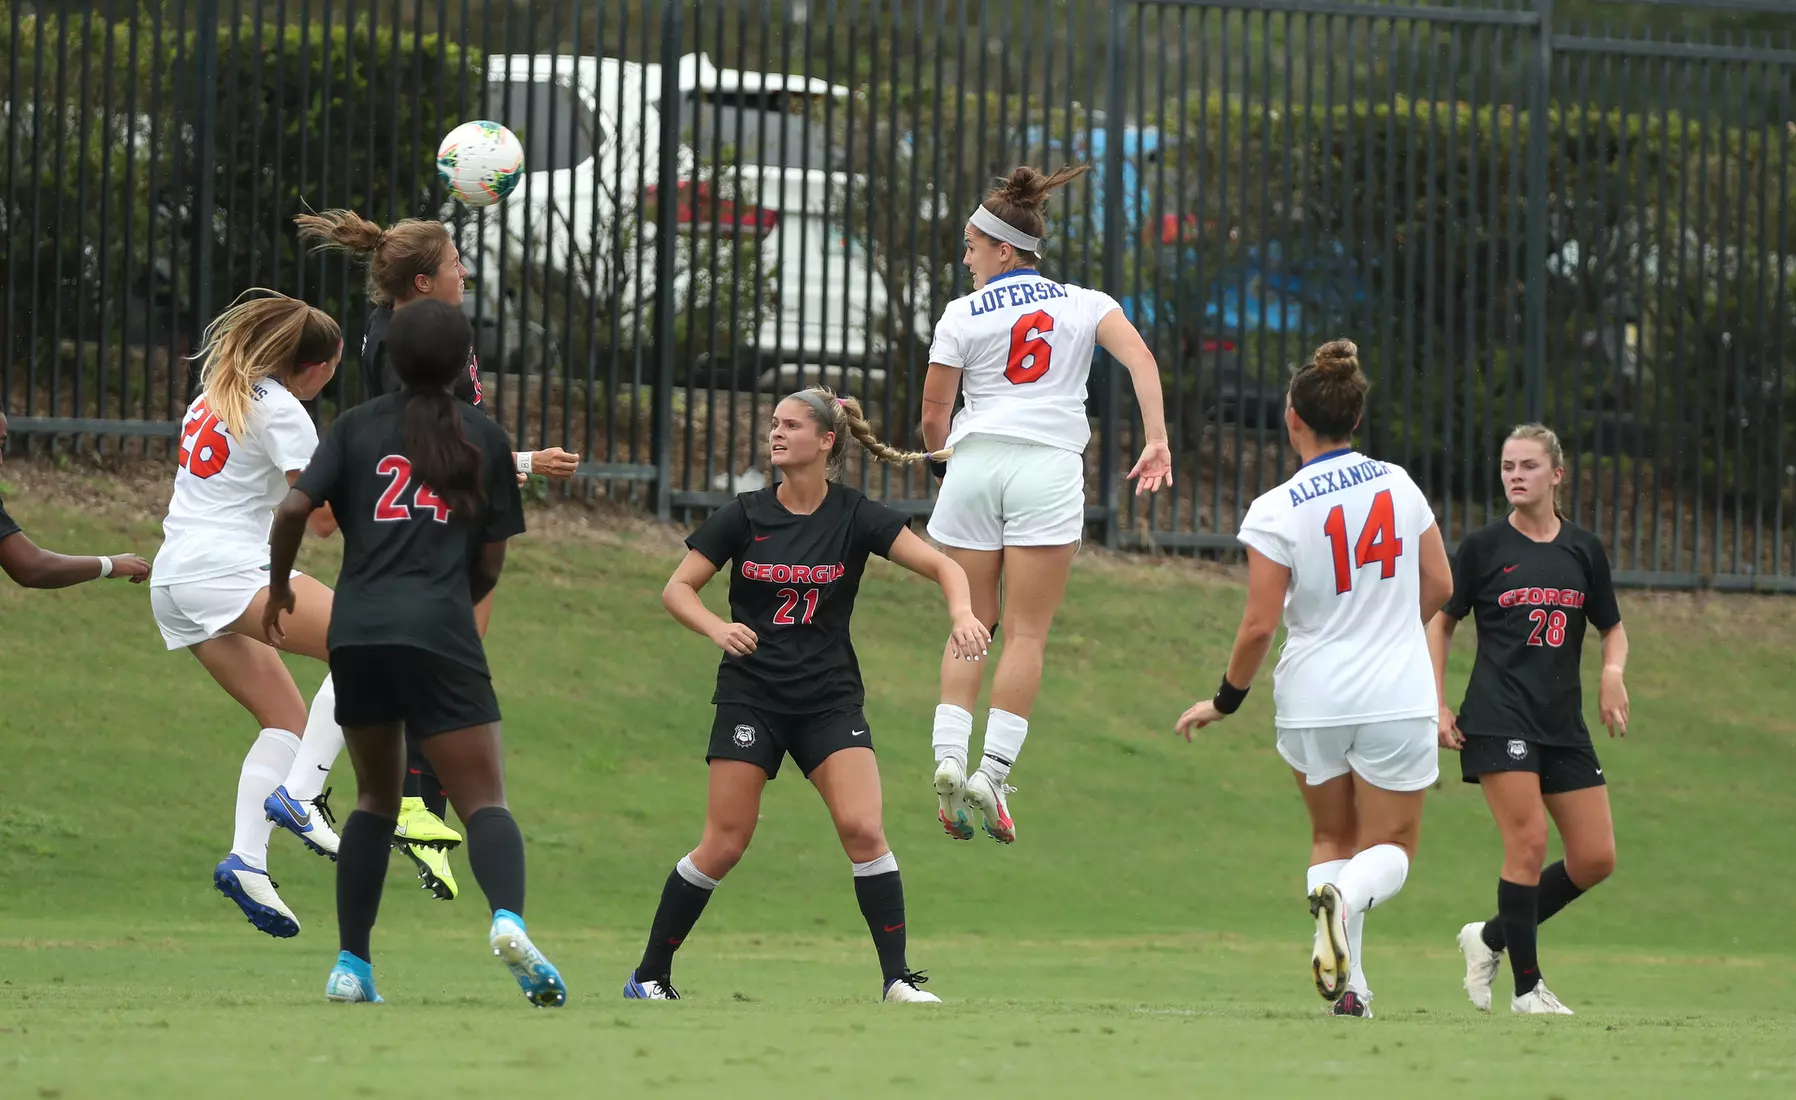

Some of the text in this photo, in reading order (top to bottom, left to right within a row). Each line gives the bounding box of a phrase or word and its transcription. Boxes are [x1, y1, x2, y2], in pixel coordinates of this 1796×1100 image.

[1003, 309, 1054, 385] 6
[178, 399, 236, 479] 26
[373, 454, 452, 523] 24
[741, 560, 845, 584] GEORGIA
[1323, 488, 1403, 596] 14
[772, 588, 819, 624] 21
[1526, 608, 1567, 647] 28
